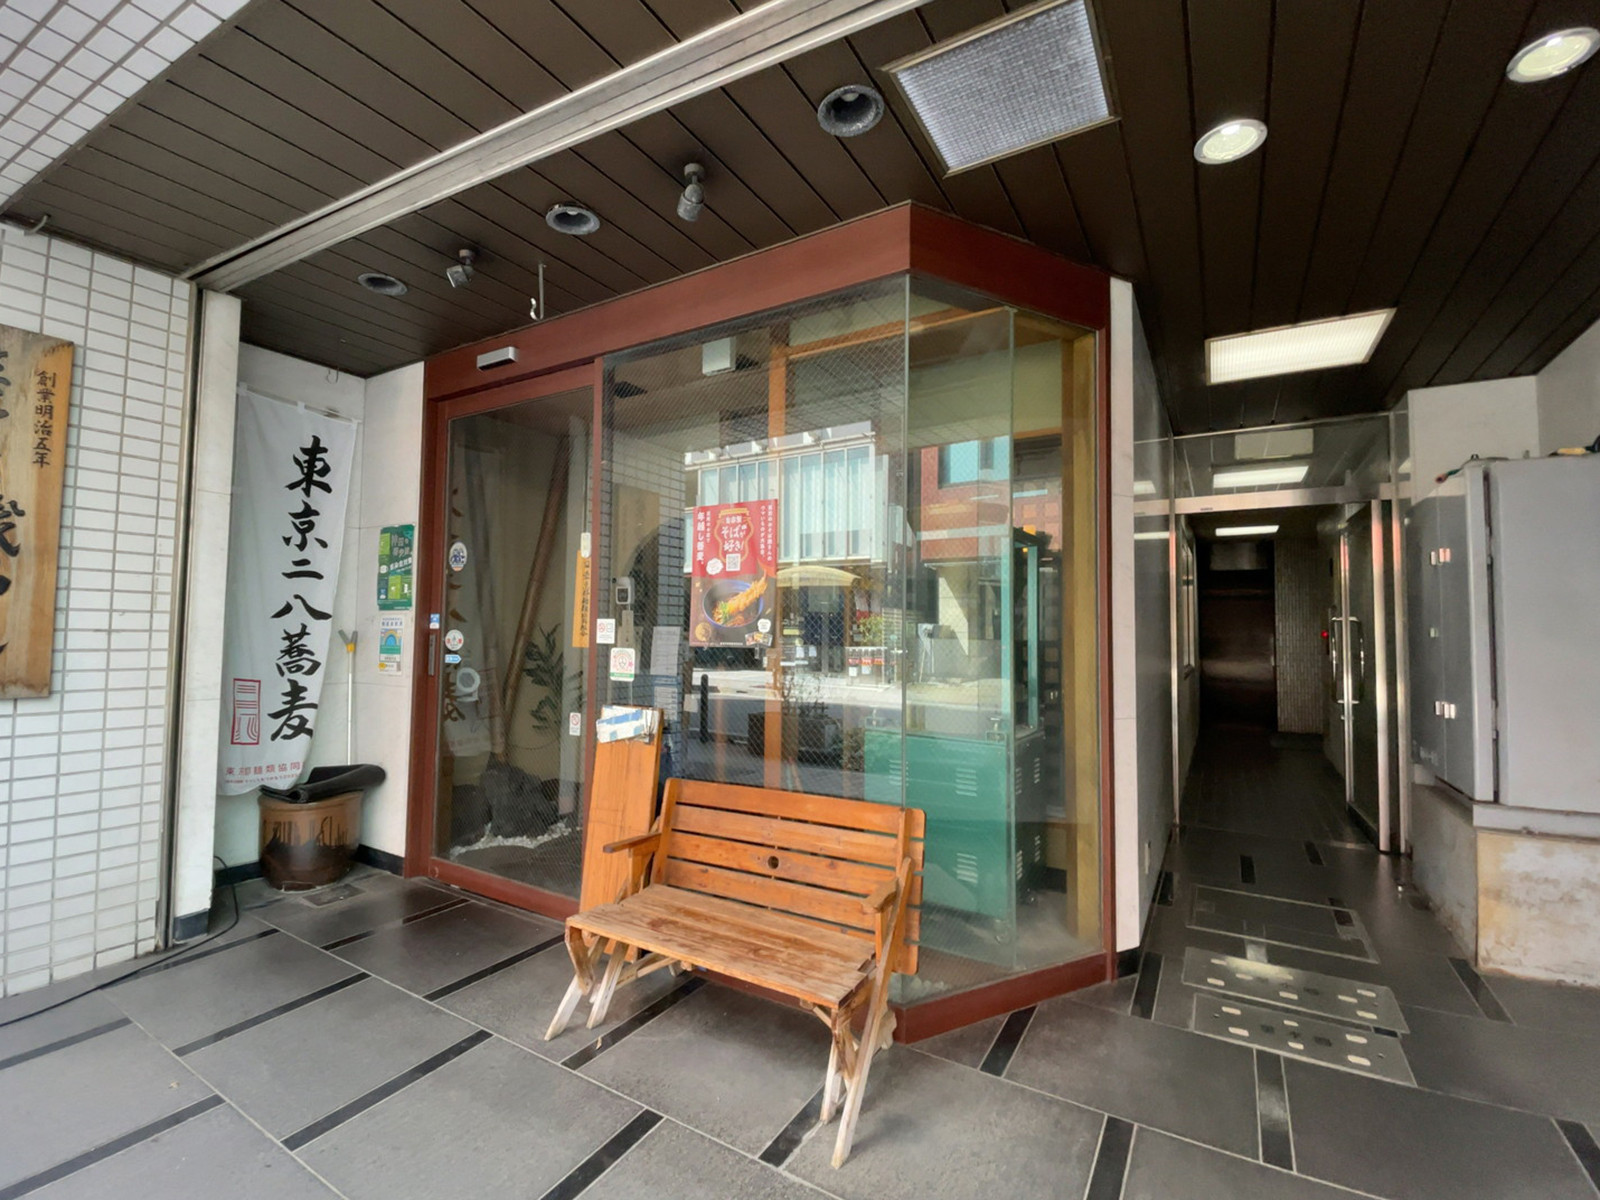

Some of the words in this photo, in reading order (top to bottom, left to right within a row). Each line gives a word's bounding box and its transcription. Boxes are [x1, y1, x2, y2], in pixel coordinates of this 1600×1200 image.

[33, 370, 56, 468] 創業明治五年
[267, 435, 333, 742] 東京二八蕎麦
